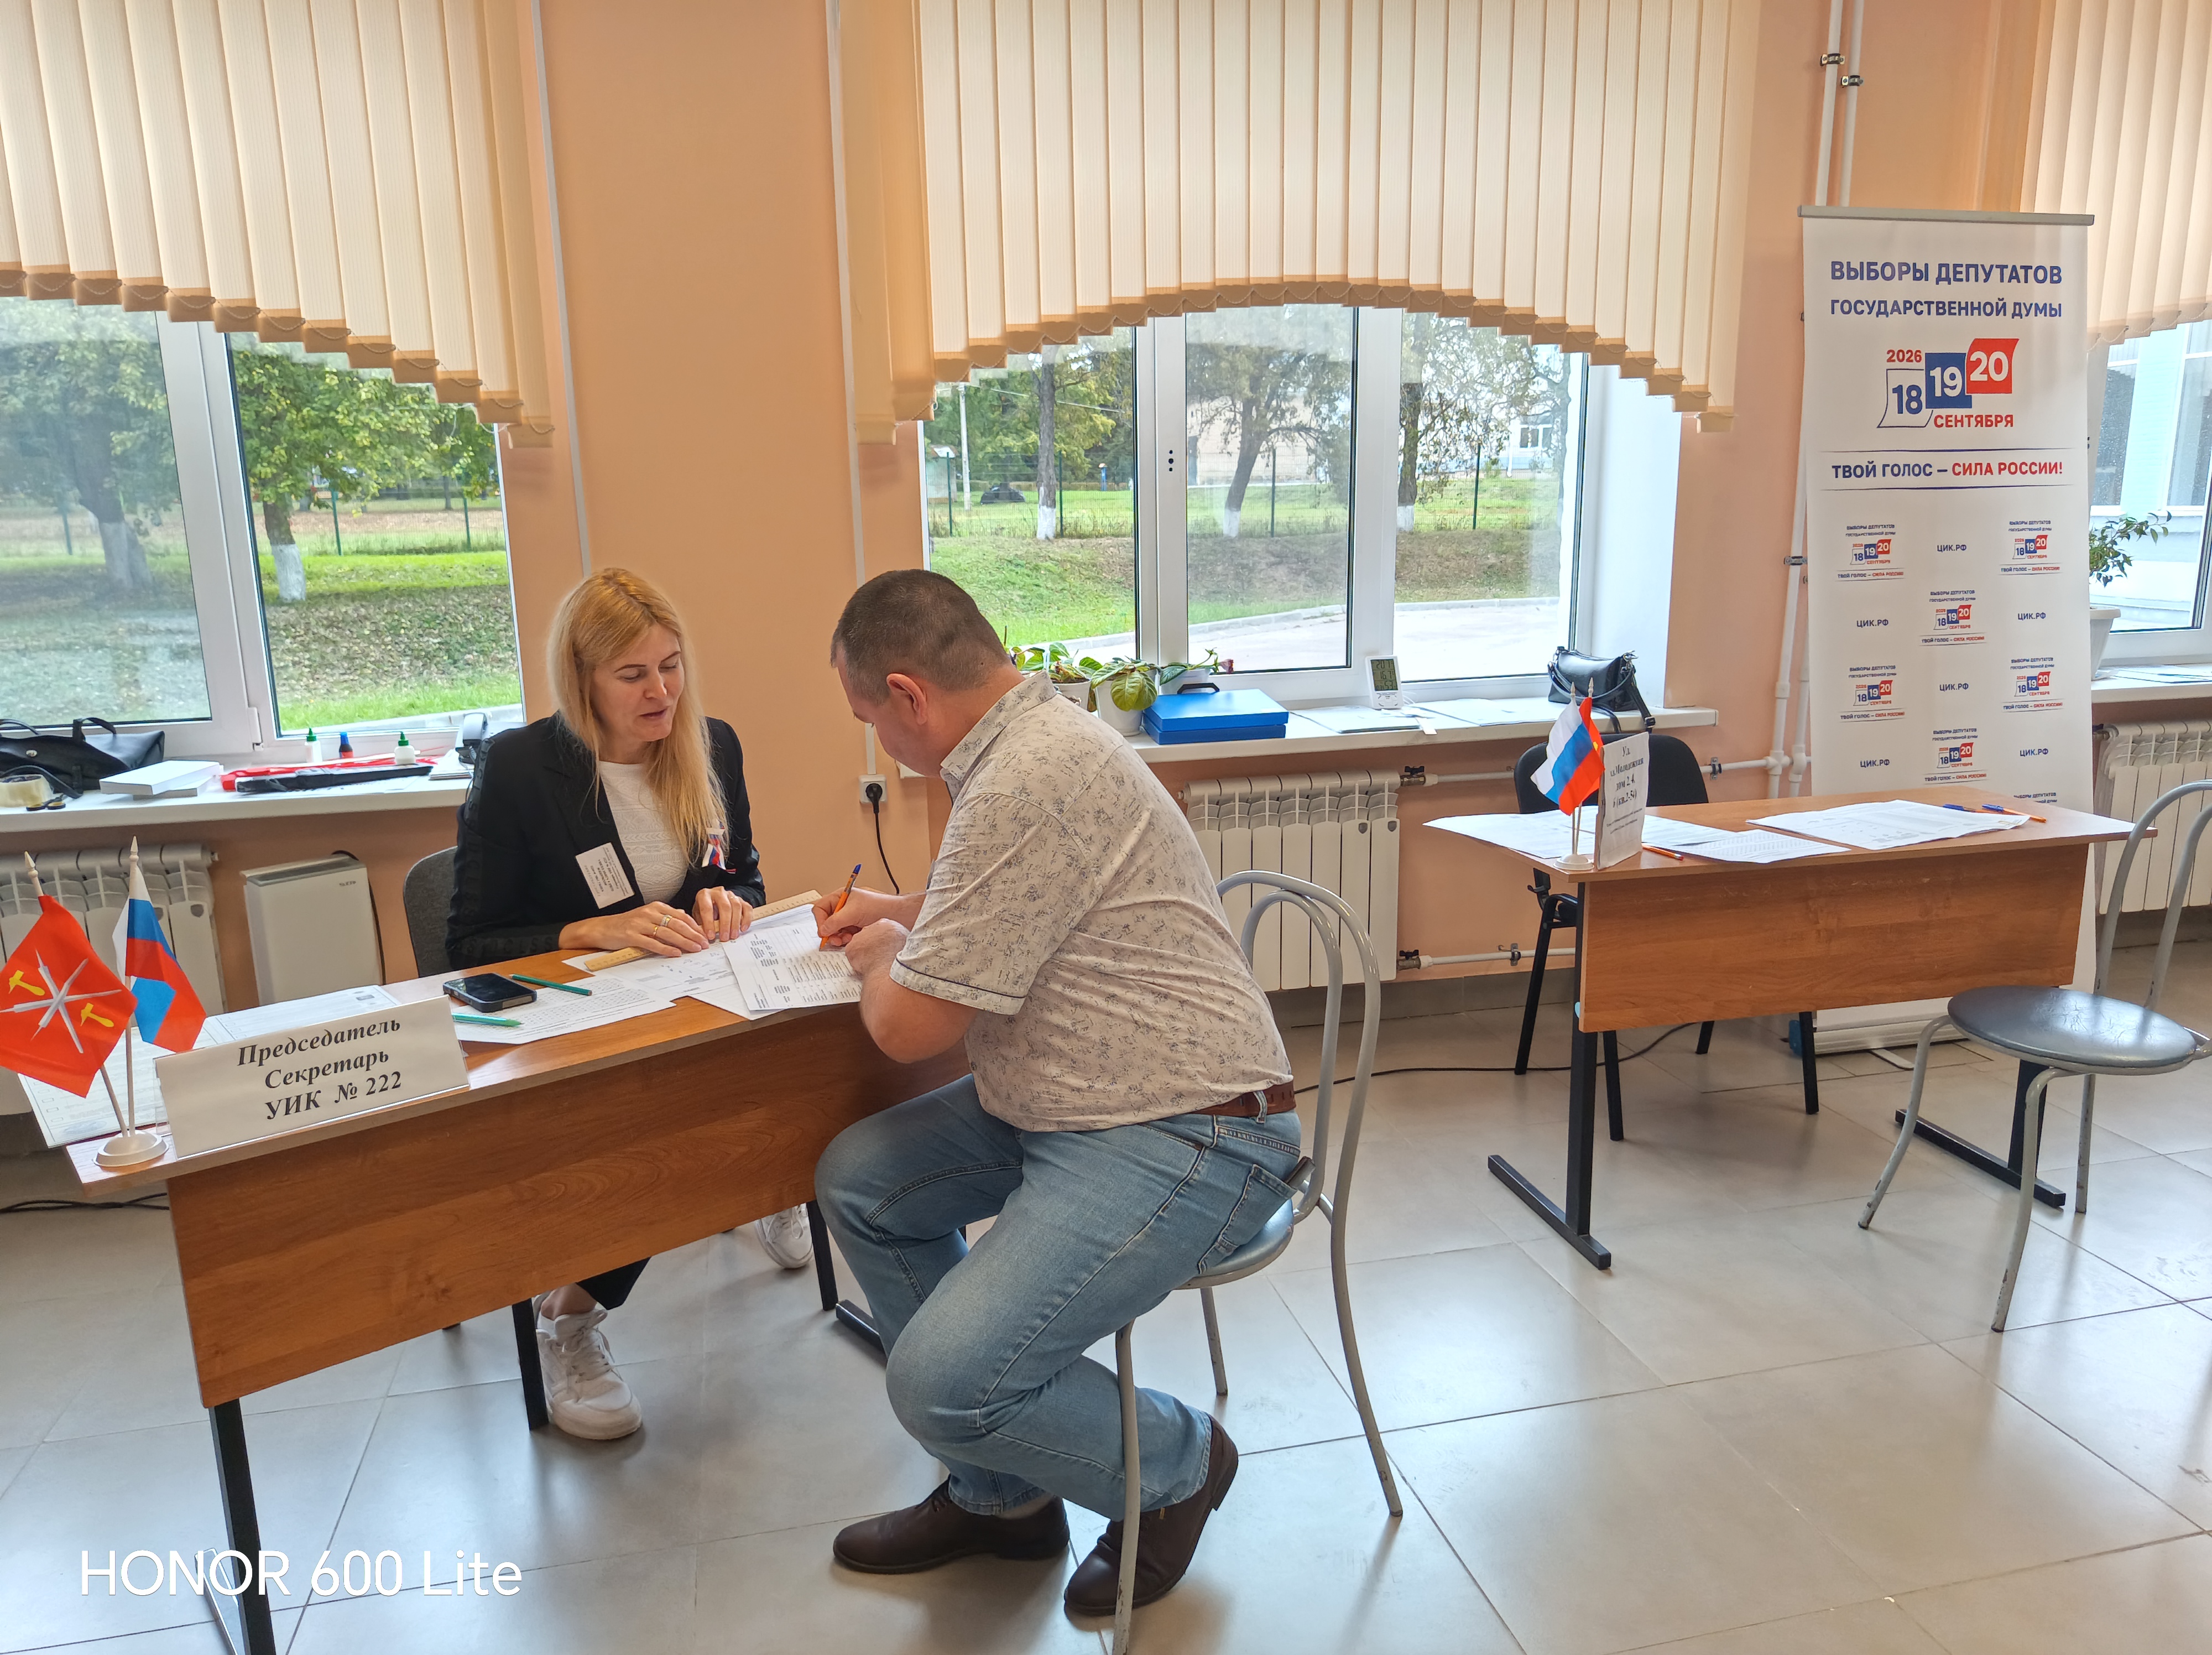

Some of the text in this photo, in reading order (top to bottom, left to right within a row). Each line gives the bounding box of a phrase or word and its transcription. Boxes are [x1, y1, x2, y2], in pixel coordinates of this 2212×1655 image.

[1831, 261, 2062, 285] ВЫБОРЫ ДЕПУТАТОВ
[1830, 298, 2062, 319] ГОСУДАРСТВЕННОЙ ДУМЫ
[1887, 350, 1922, 362] 2026
[1892, 351, 2008, 414] 18 19 20
[1934, 415, 2013, 428] СЕНТЯБРЯ
[1832, 461, 1876, 478] ТВОЙ
[1882, 464, 1932, 477] ГОЛОС
[1952, 462, 1993, 476] СИЛА
[1998, 461, 2063, 475] РОССИИ!
[1865, 547, 1875, 555] 19
[1877, 543, 1888, 551] 20
[1938, 608, 1969, 626] 18 19 20
[2018, 612, 2046, 621] ЦИК.РФ
[1856, 619, 1888, 628] ЦИК.РФ
[1869, 689, 1878, 697] 19
[1880, 684, 1890, 693] 20
[1939, 683, 1969, 691] ЦИК.РФ
[1961, 746, 1971, 754] 20
[2020, 748, 2048, 757] ЦИК.РФ
[1860, 759, 1890, 768] ЦИК.РФ
[237, 1018, 401, 1066] Председатель
[265, 1051, 389, 1089] Секретарь
[265, 1071, 402, 1120] УИК № 222
